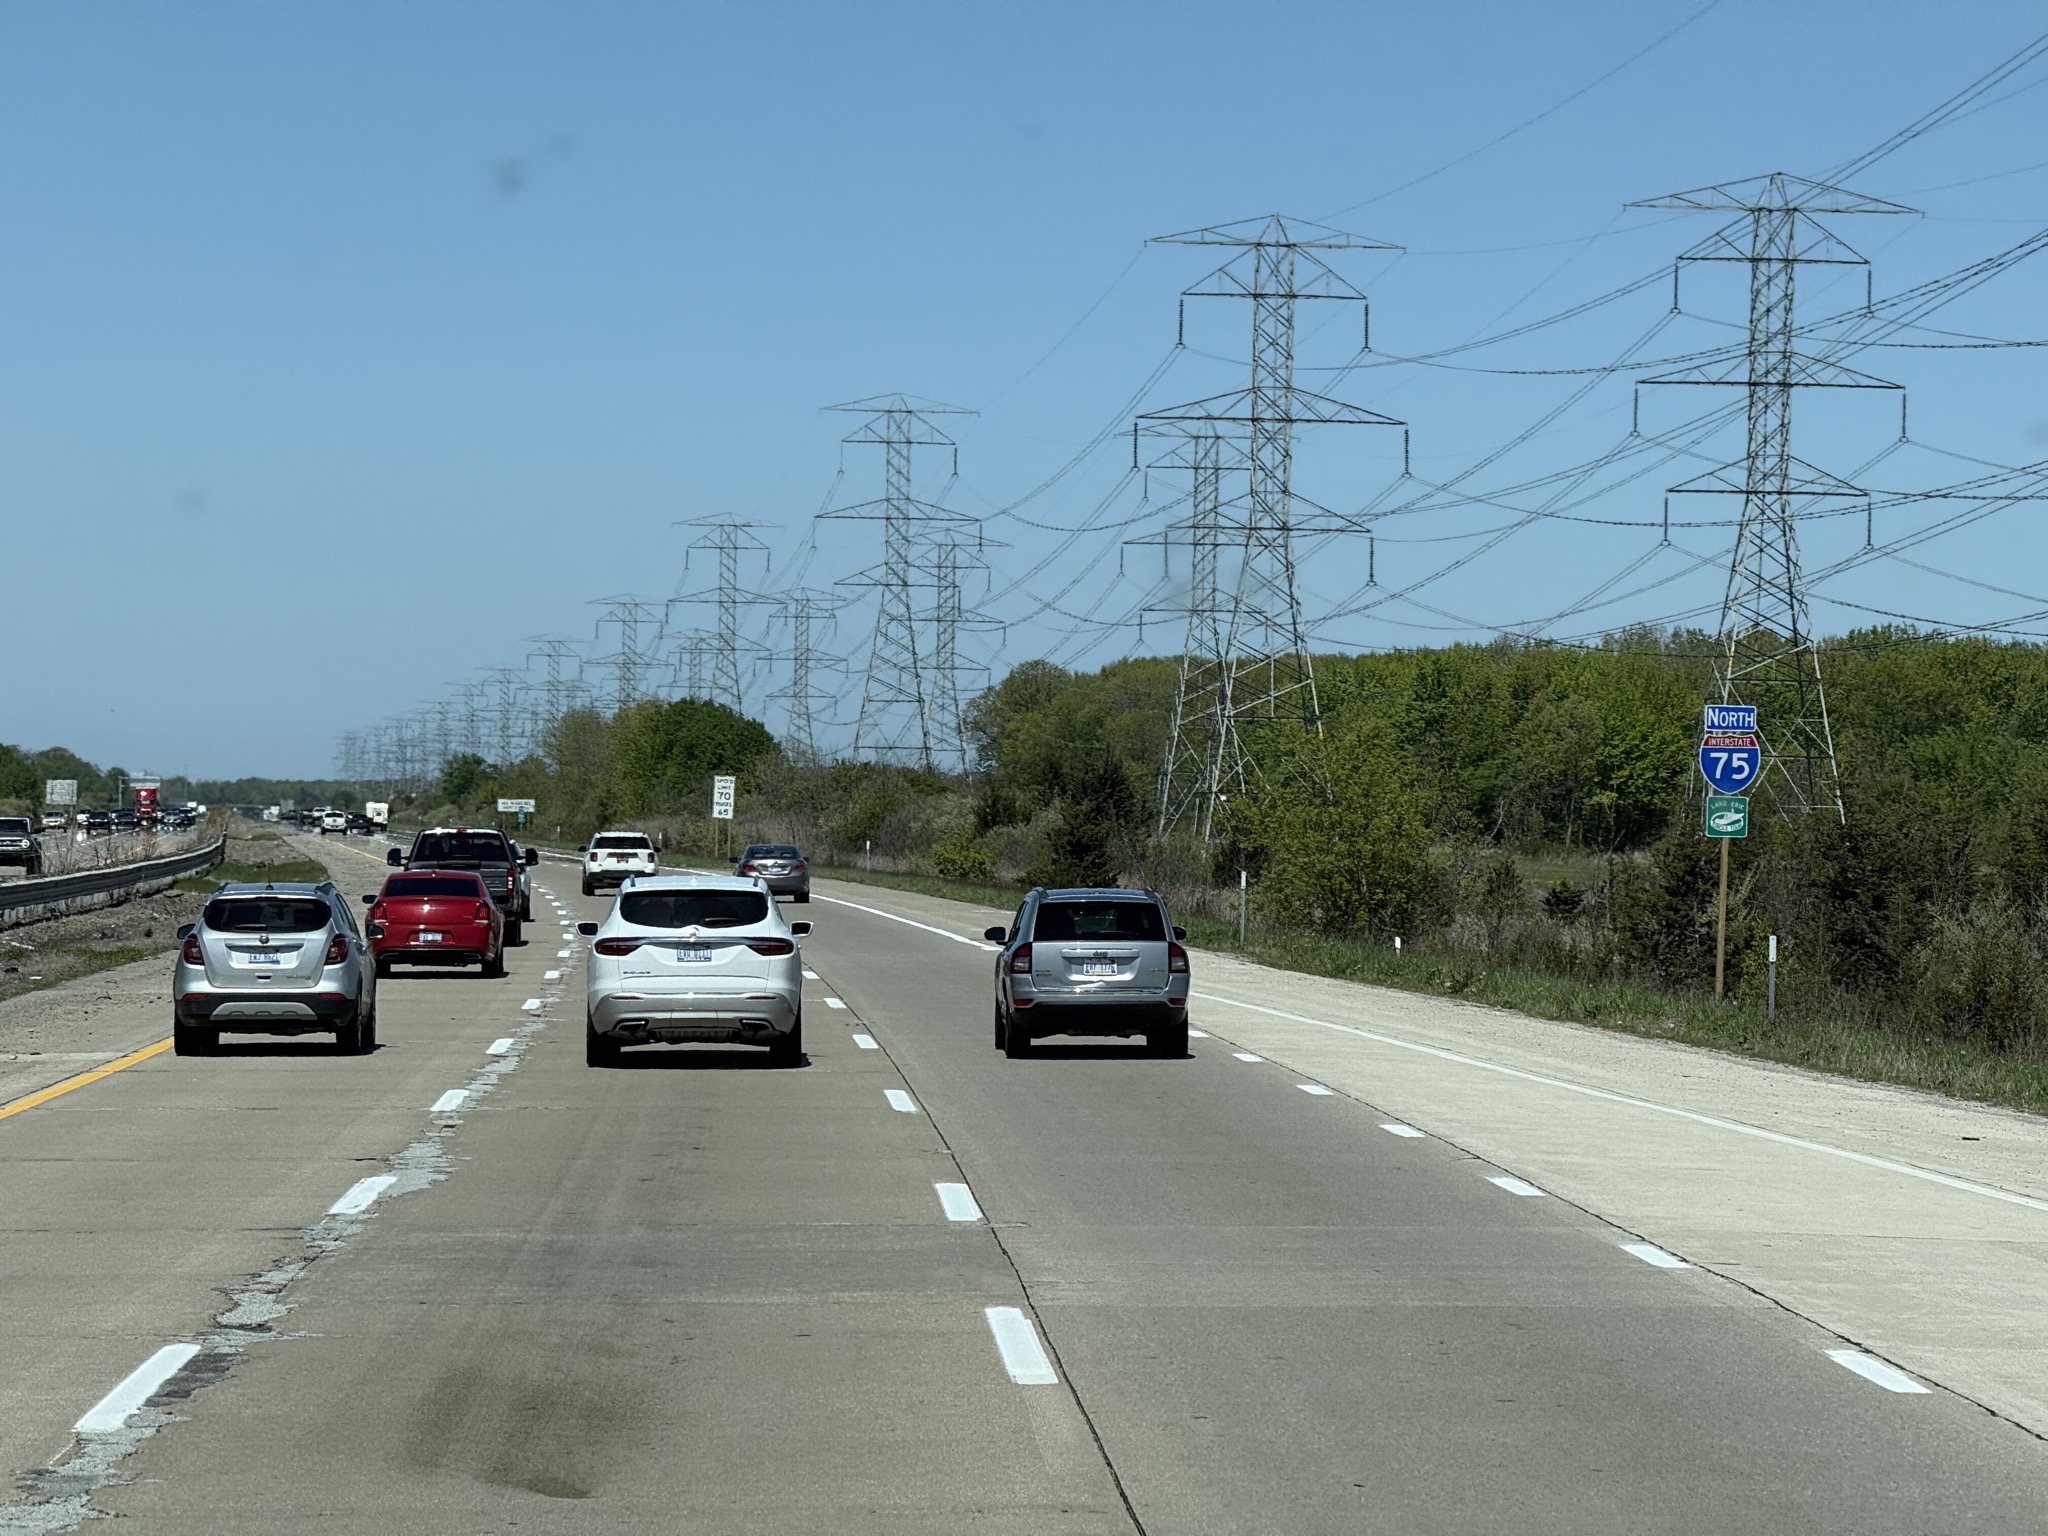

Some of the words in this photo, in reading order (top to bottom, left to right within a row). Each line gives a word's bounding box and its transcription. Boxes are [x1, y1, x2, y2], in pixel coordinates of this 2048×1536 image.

[1707, 708, 1754, 727] NORTH
[1708, 738, 1751, 747] INTERSTATE
[1709, 752, 1750, 780] 75
[717, 791, 731, 801] 70
[1710, 800, 1728, 810] LAKE
[1730, 801, 1745, 811] ERIE
[717, 808, 729, 816] 65
